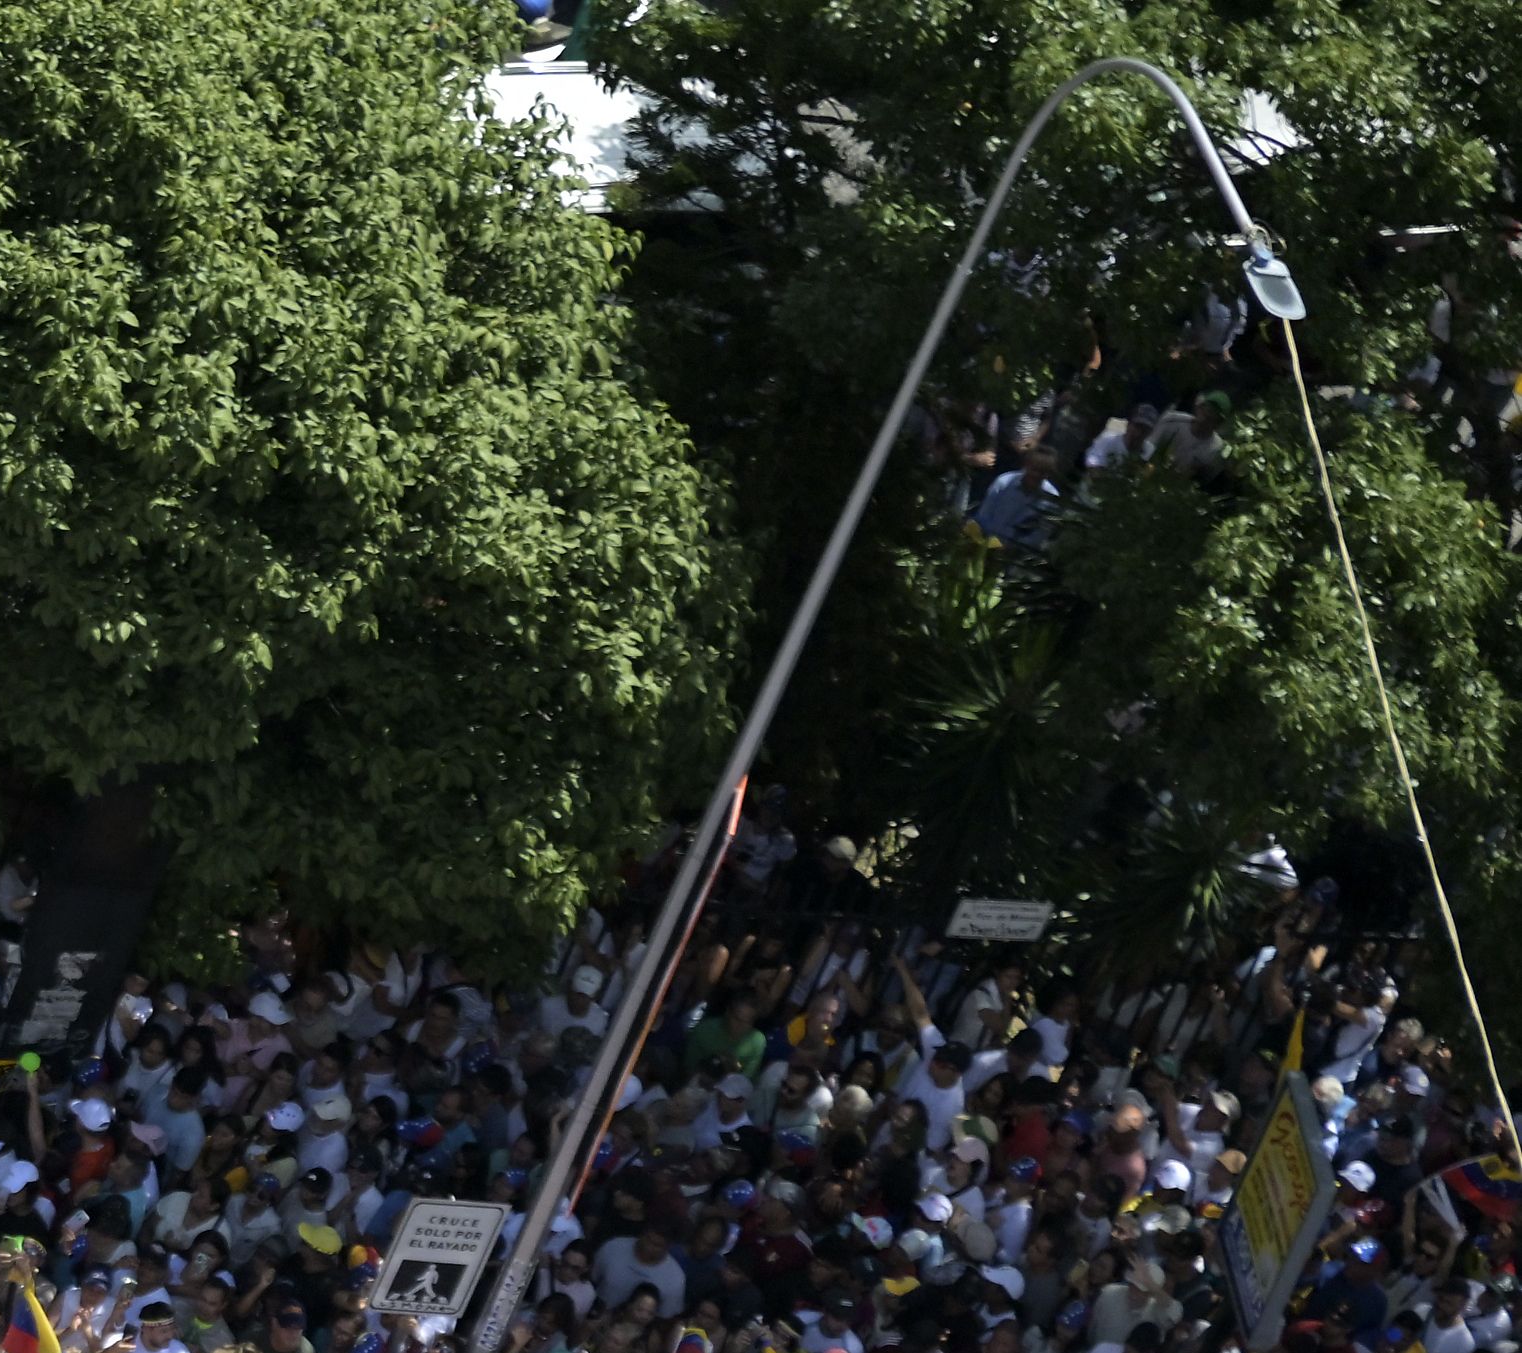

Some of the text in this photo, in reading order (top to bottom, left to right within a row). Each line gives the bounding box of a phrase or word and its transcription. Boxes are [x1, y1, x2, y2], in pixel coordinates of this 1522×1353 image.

[429, 1216, 480, 1228] CRUCE
[415, 1227, 482, 1240] SOLO POR
[409, 1239, 477, 1252] EL RAYADO
